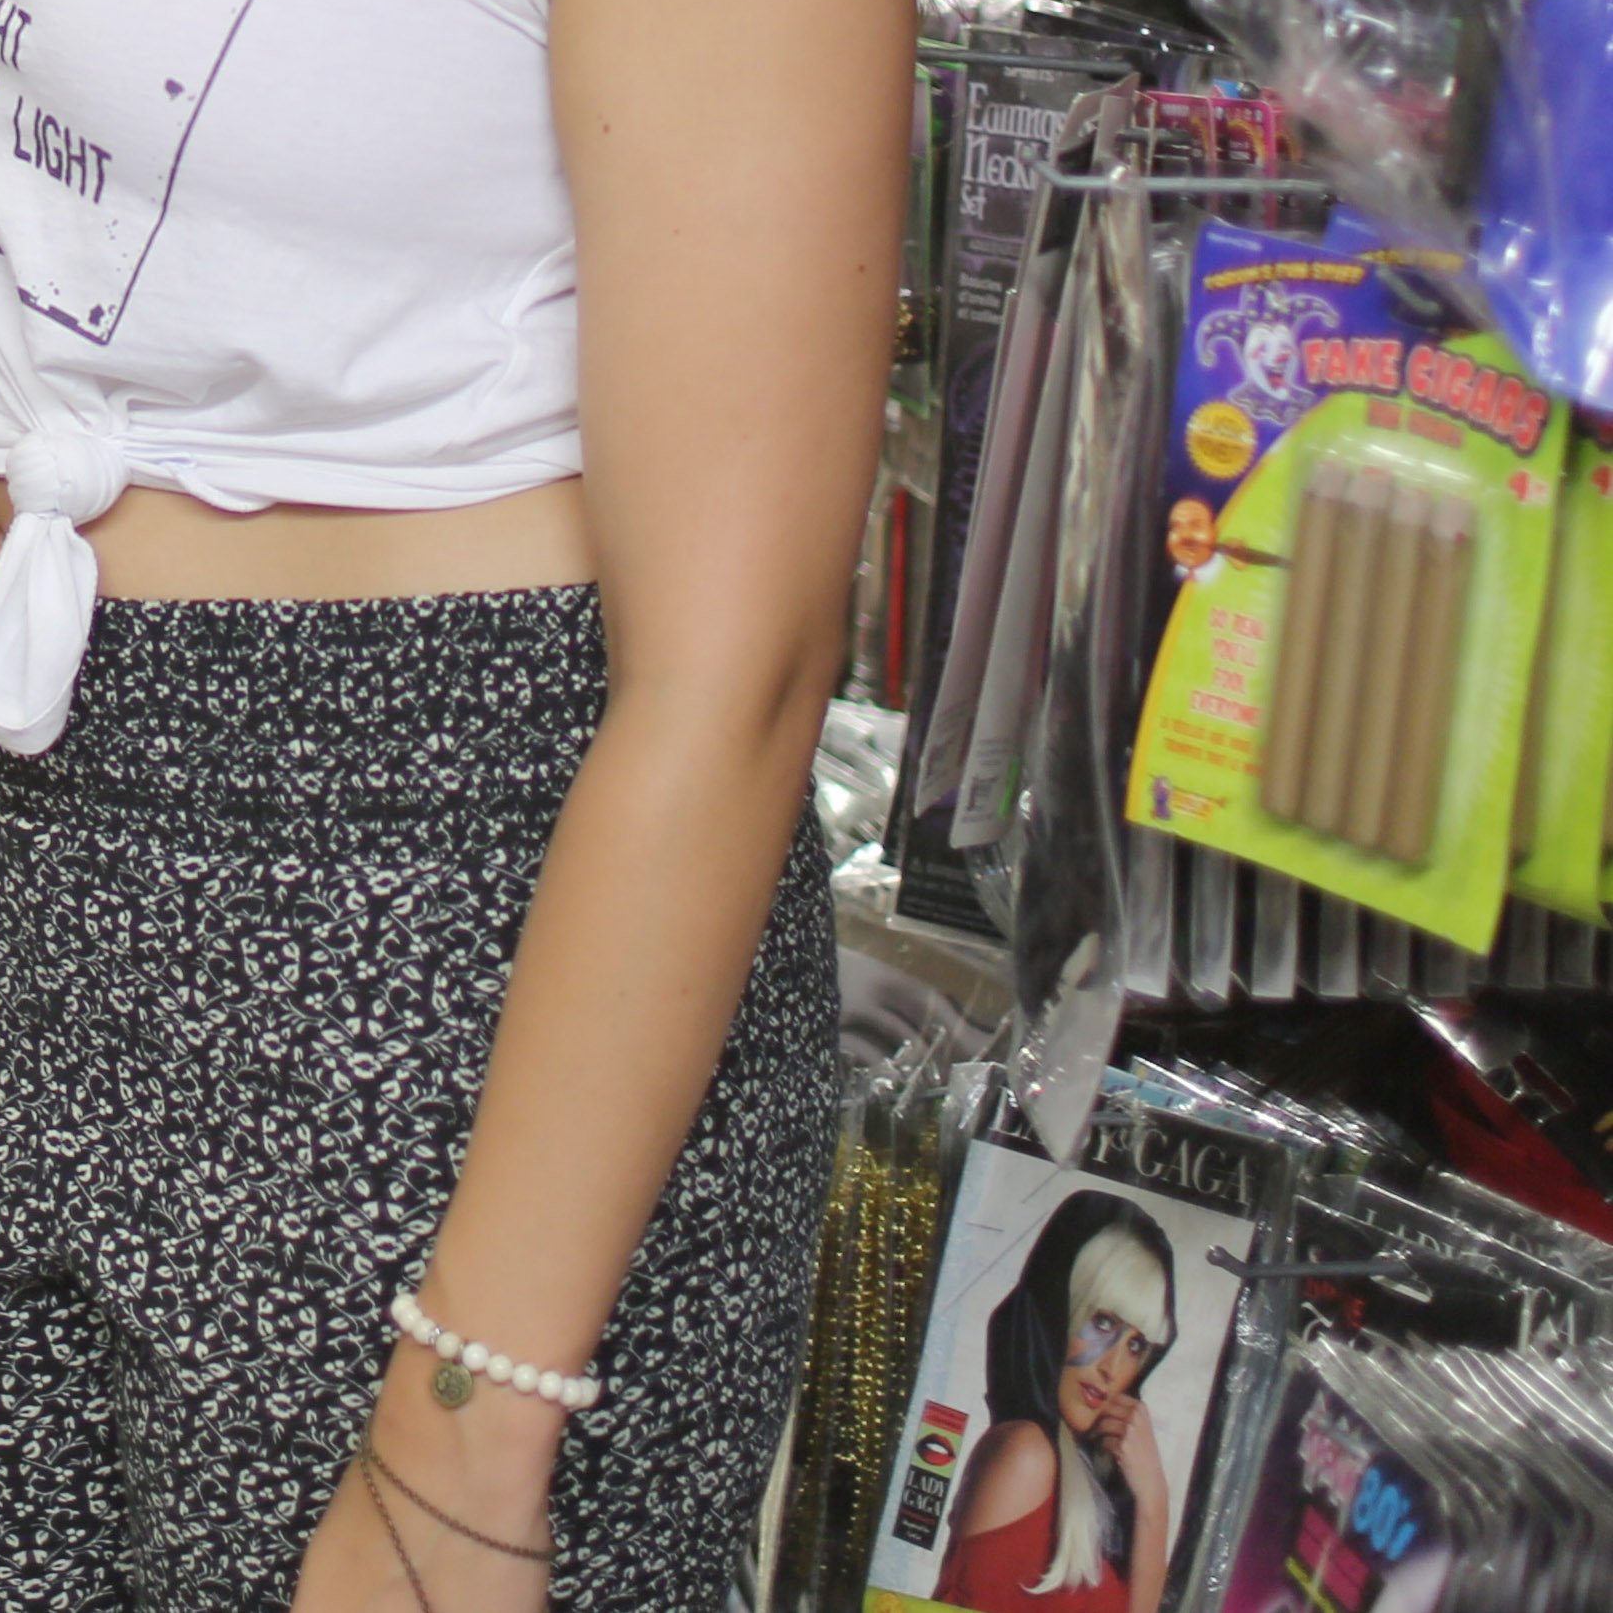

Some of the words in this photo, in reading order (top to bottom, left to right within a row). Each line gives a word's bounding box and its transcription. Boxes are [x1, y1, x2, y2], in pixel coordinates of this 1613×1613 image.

[12, 94, 113, 205] LIGHT
[959, 184, 988, 223] Set
[1300, 336, 1403, 391] FAKE
[1405, 343, 1552, 454] CIGARS
[1133, 1128, 1256, 1207] GAGA
[902, 1488, 942, 1517] GAGA
[906, 1469, 946, 1496] LADY
